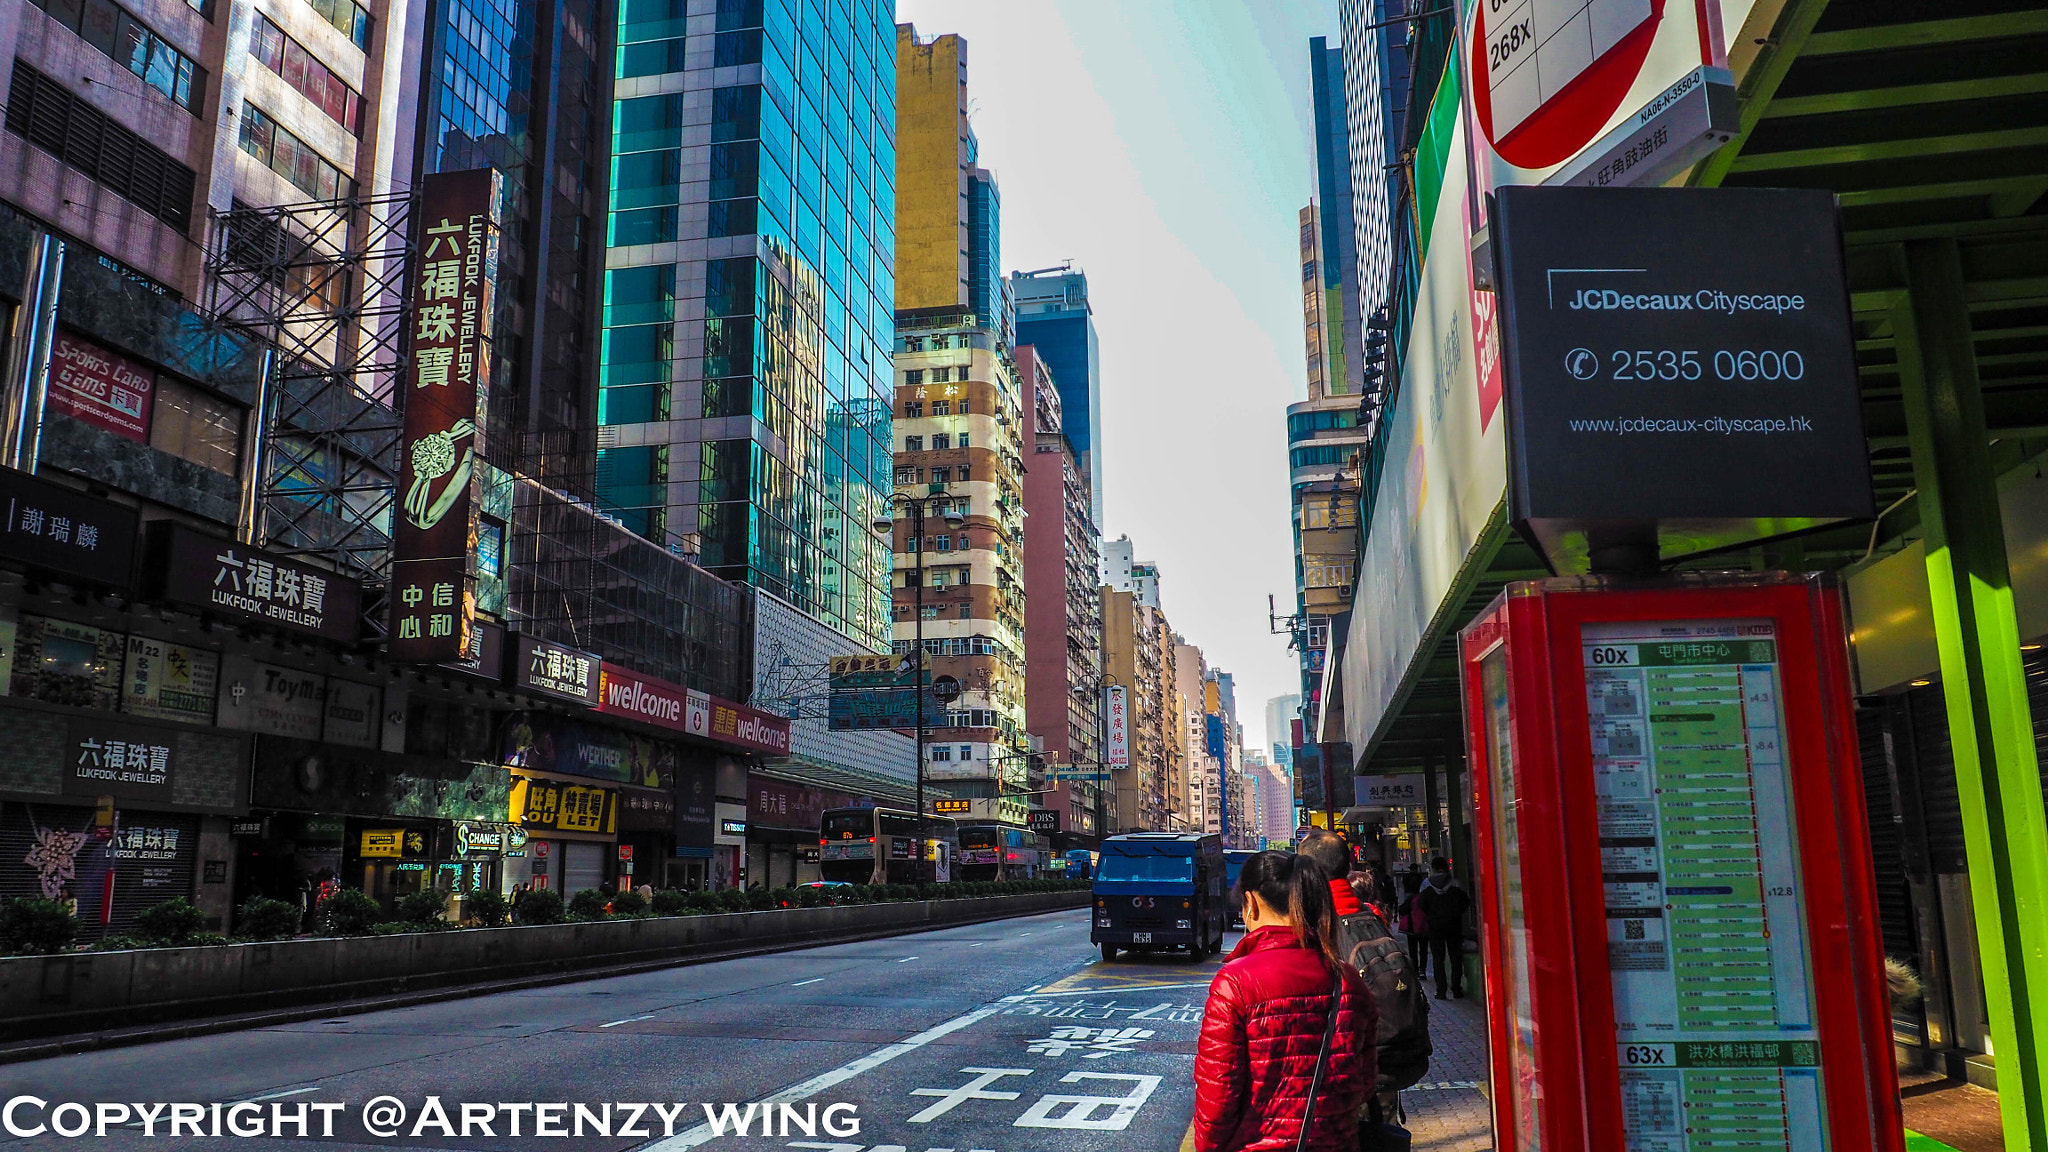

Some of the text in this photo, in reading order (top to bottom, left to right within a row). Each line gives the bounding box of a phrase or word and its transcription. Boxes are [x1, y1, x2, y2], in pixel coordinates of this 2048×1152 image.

[415, 218, 464, 389] 六福珠寶
[457, 214, 483, 384] LUKFOOK JEWELLERY
[1569, 289, 1805, 315] JCDecaux Cityscape
[1612, 350, 1805, 380] 2535 0600
[1569, 415, 1813, 436] www.jcdecaux-cityscape.hk
[21, 505, 99, 551] 謝瑞麟
[213, 550, 327, 614] 六福珠寶
[211, 589, 323, 630] LUKFOOK JEWELLERY
[1658, 643, 1731, 658] 屯門市中心
[530, 645, 590, 687] 六福珠寶
[529, 674, 556, 690] LUKFOOK
[557, 680, 588, 698] JEWELLERY
[608, 680, 680, 722] wellcome
[713, 705, 786, 749] 惠康 wellcome
[78, 737, 169, 773] 六福珠寶
[76, 767, 167, 785] LUKFOOK JEWELLERY
[530, 786, 601, 817] 旺角 特賣場
[528, 811, 599, 827] OUTLET
[1034, 813, 1055, 823] DBS
[106, 826, 180, 850] 六福珠寶
[468, 832, 500, 845] CHANGE
[105, 849, 137, 859] LKFOOK
[1688, 1043, 1780, 1060] 洪水橋洪福邨
